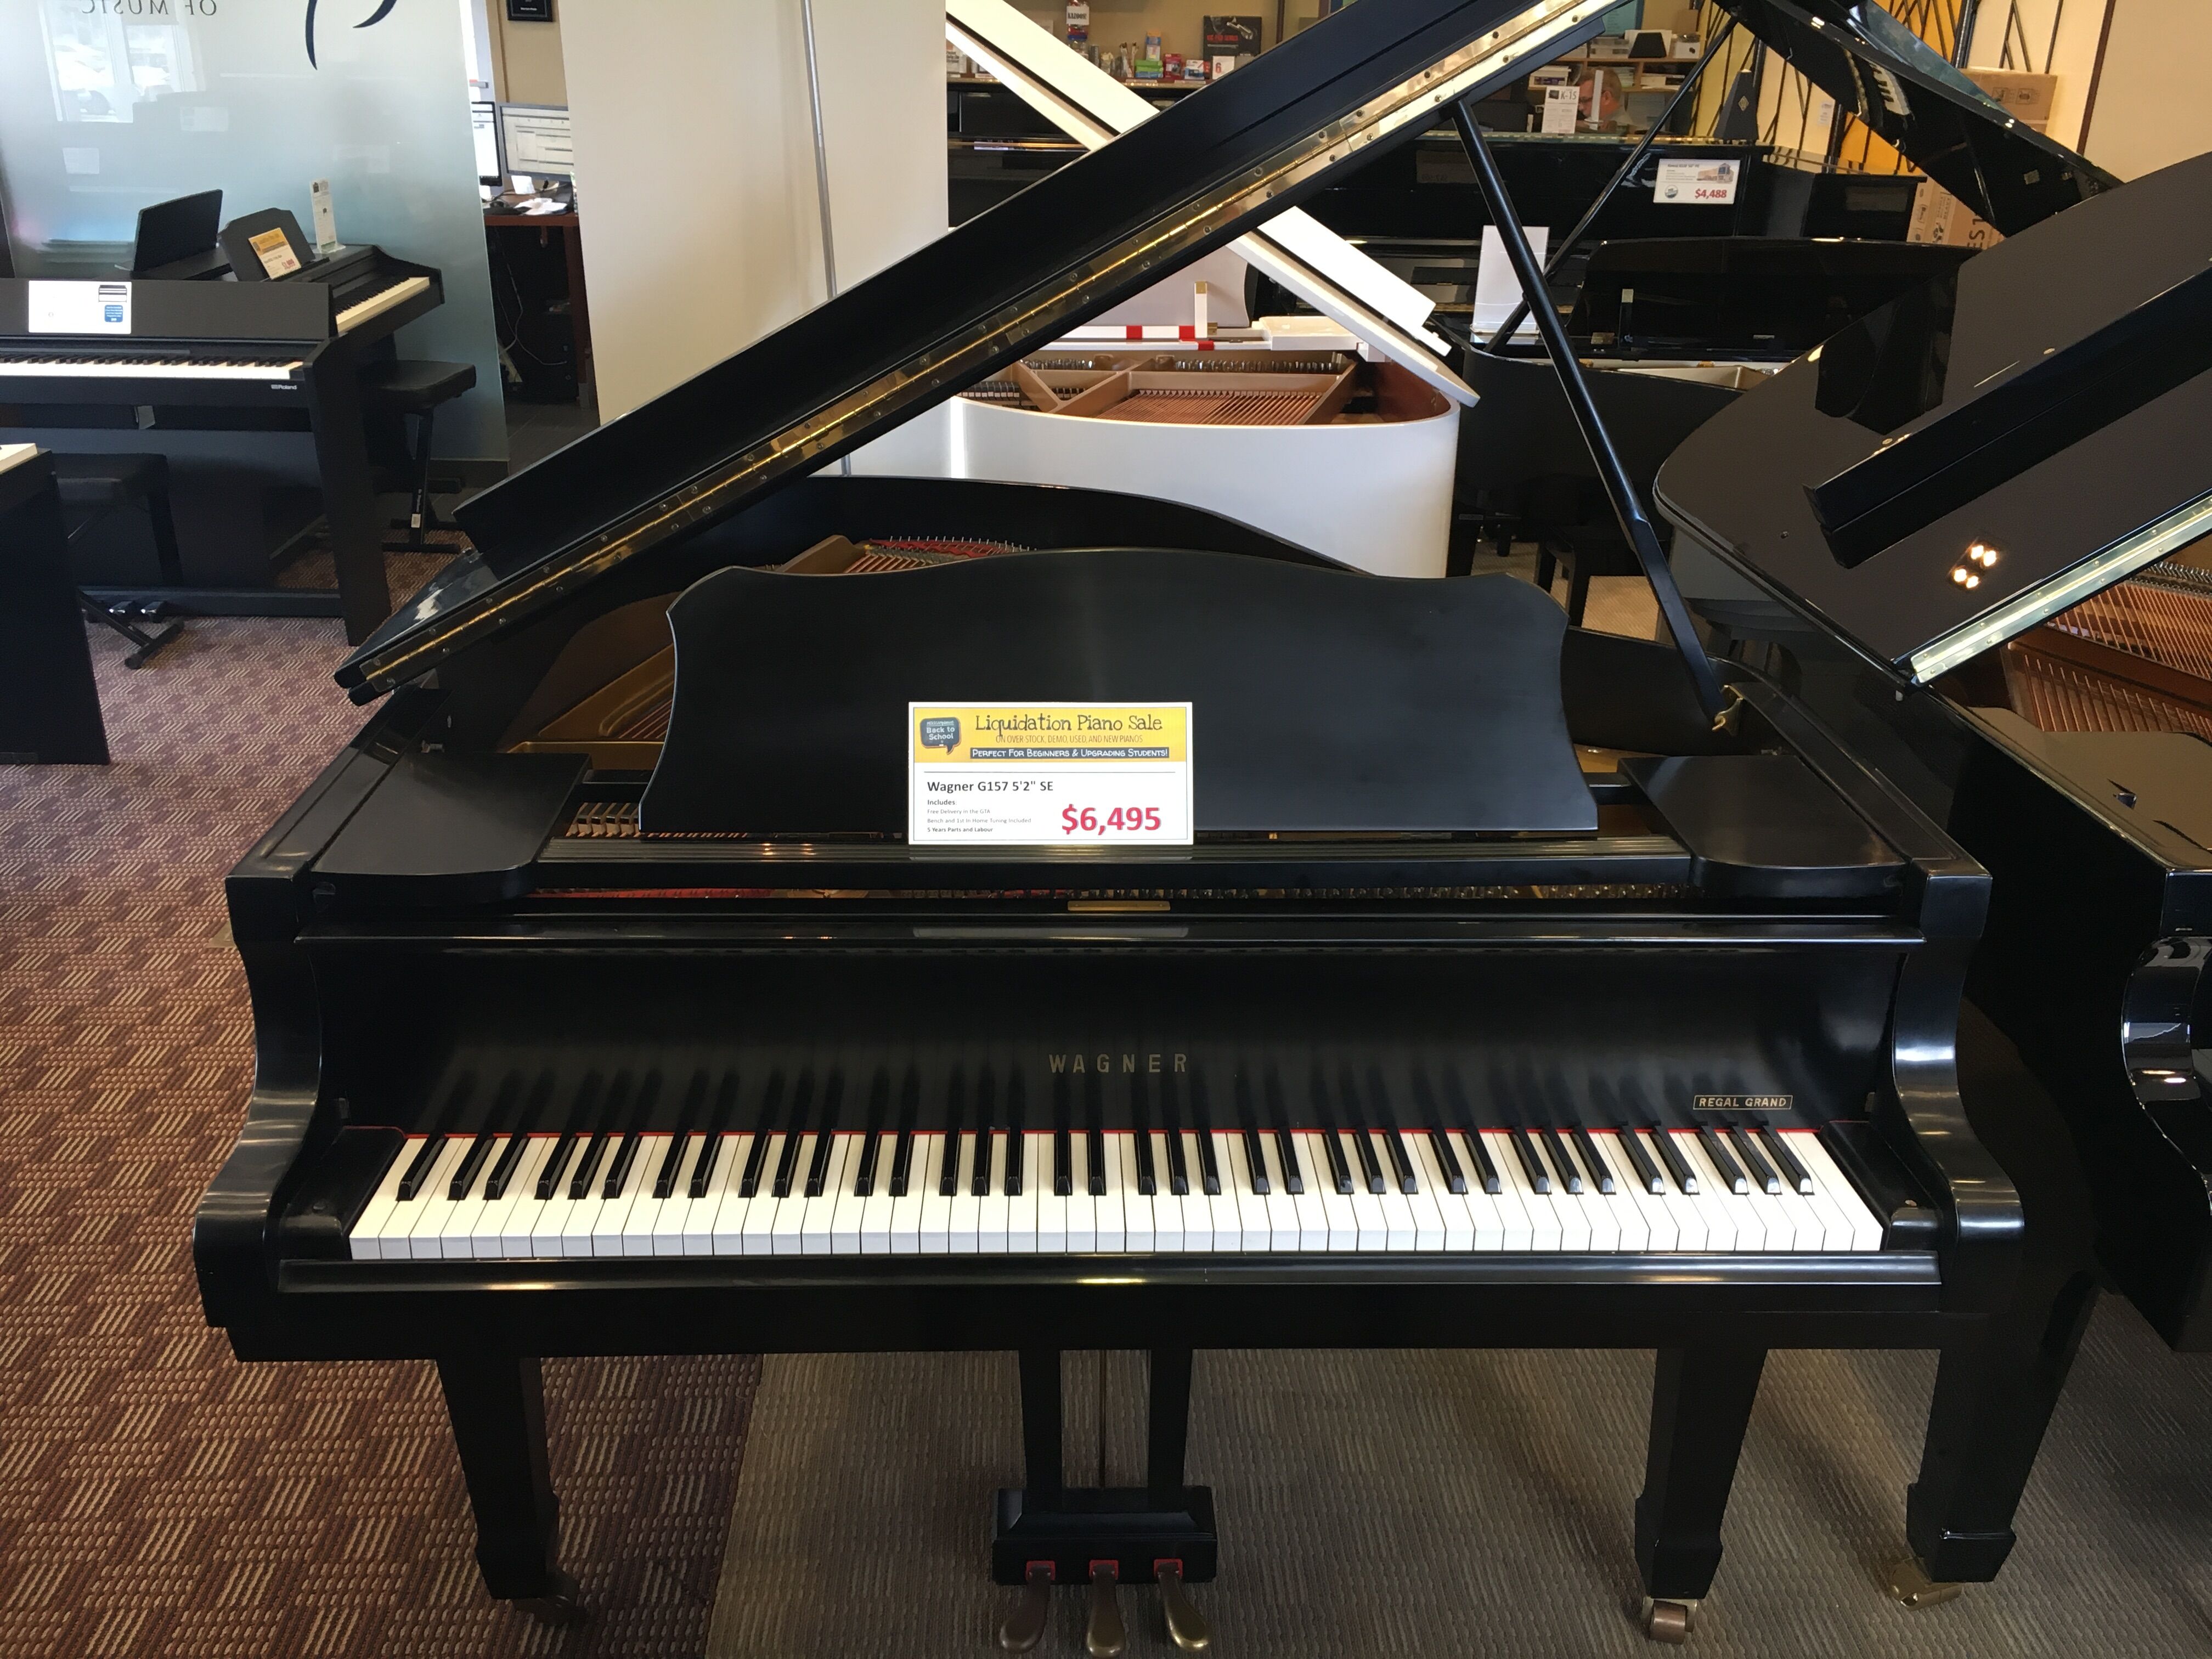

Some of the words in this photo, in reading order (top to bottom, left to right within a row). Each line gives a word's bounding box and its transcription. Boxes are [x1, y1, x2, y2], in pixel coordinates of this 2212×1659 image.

[1695, 188, 1727, 200] $4,488
[975, 713, 1072, 737] Liquidation
[1077, 714, 1123, 731] Piano
[1128, 714, 1163, 730] Sale
[996, 735, 1006, 743] ON
[972, 749, 1006, 757] PERFECT
[1008, 749, 1024, 757] FOR
[1026, 749, 1070, 757] BEGINNERS
[1071, 749, 1079, 757] &
[1081, 749, 1126, 757] UPGRADING
[1127, 748, 1168, 757] STUDENTS!
[927, 781, 974, 794] Wagner
[978, 781, 1008, 791] G157
[1012, 781, 1036, 791] 5'2"
[1040, 781, 1053, 791] SE
[1062, 804, 1162, 836] $6,495
[1048, 1053, 1187, 1074] WAGNER
[1699, 1097, 1739, 1107] REGAL
[1745, 1097, 1787, 1107] GRAND
